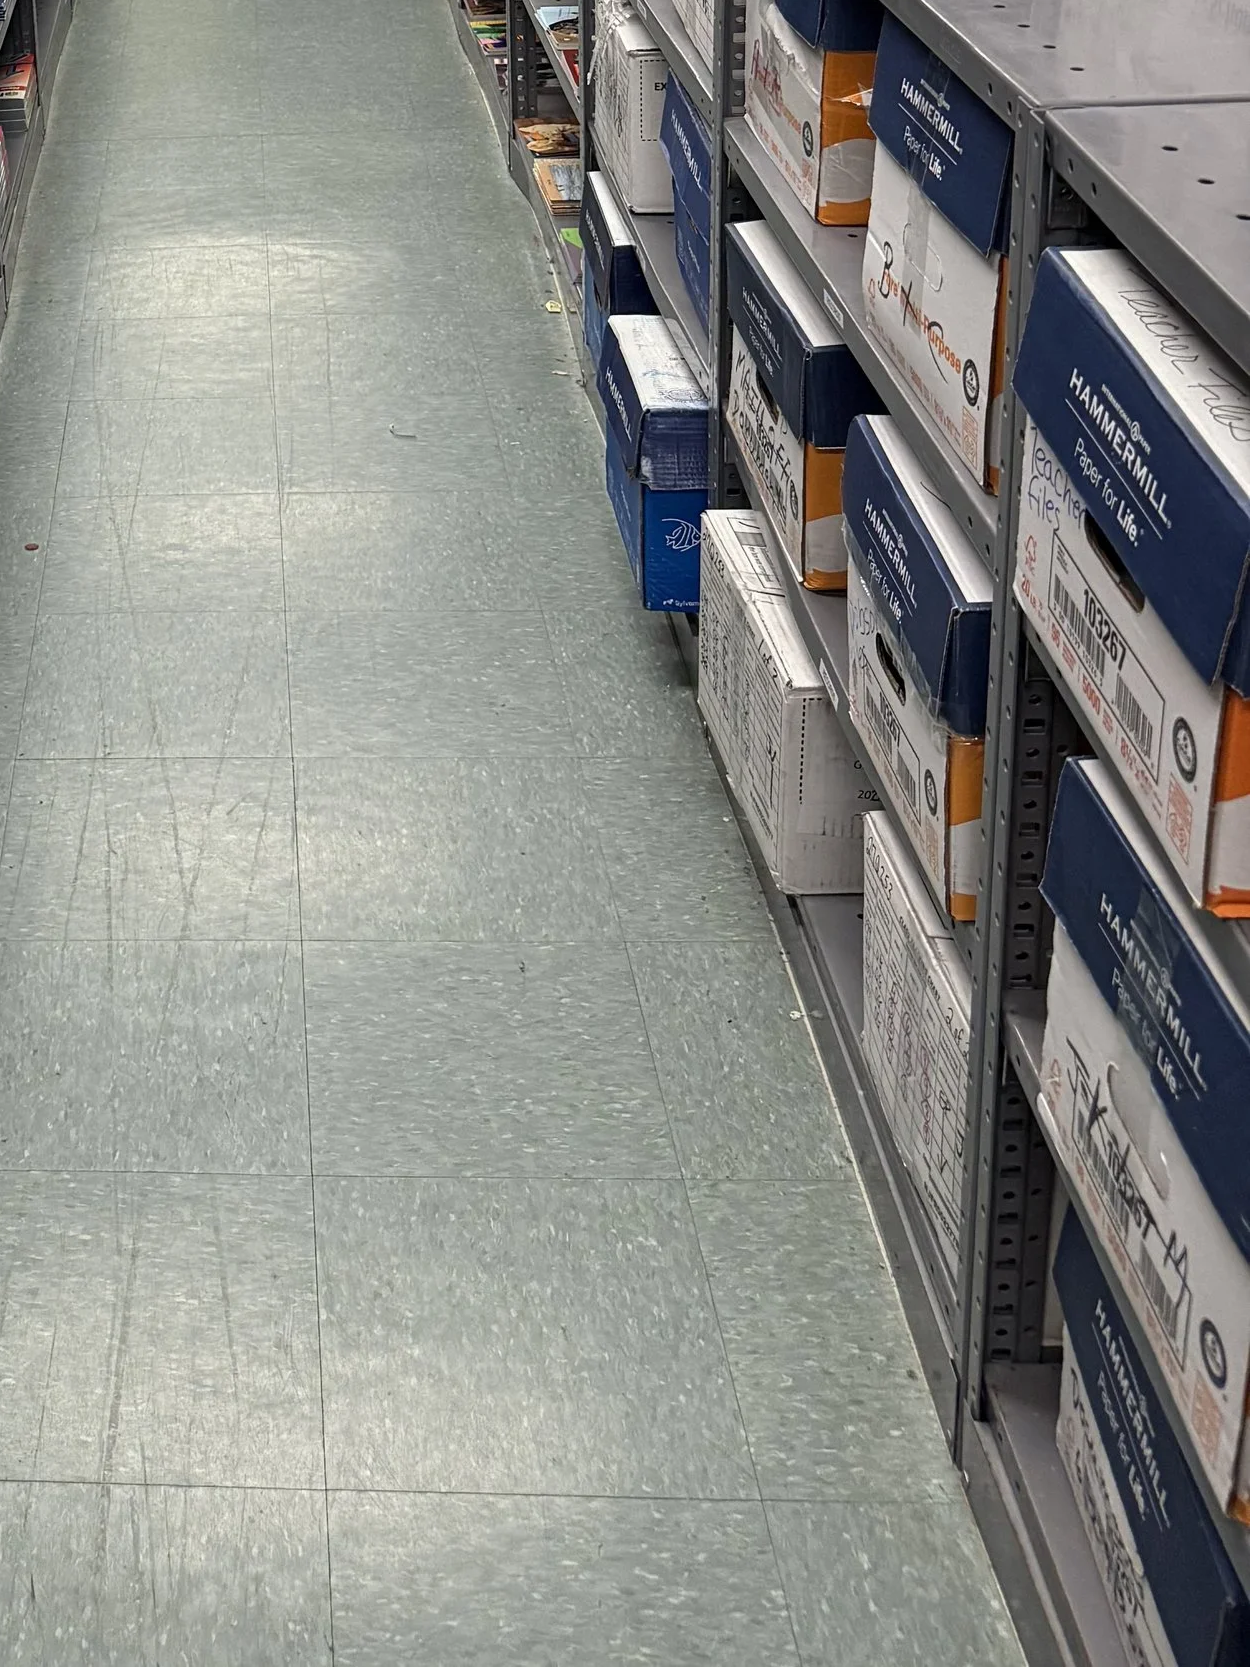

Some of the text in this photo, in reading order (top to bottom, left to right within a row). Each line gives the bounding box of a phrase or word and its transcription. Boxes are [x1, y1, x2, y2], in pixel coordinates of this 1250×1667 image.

[900, 77, 963, 155] HAMMERMILL
[903, 124, 920, 157] Paper
[919, 141, 930, 168] for
[1118, 288, 1199, 375] Teacher
[1069, 367, 1172, 529] HAMMERMILL
[1101, 383, 1152, 455] INTERNATIONAL PAPER
[1074, 437, 1103, 487] Paper
[1102, 477, 1119, 511] for
[864, 497, 918, 609] HAMMERMILL
[1083, 588, 1127, 671] 103267
[1100, 892, 1208, 1092] HAMMERMILL
[1096, 1298, 1171, 1529] HAMMERMILL
